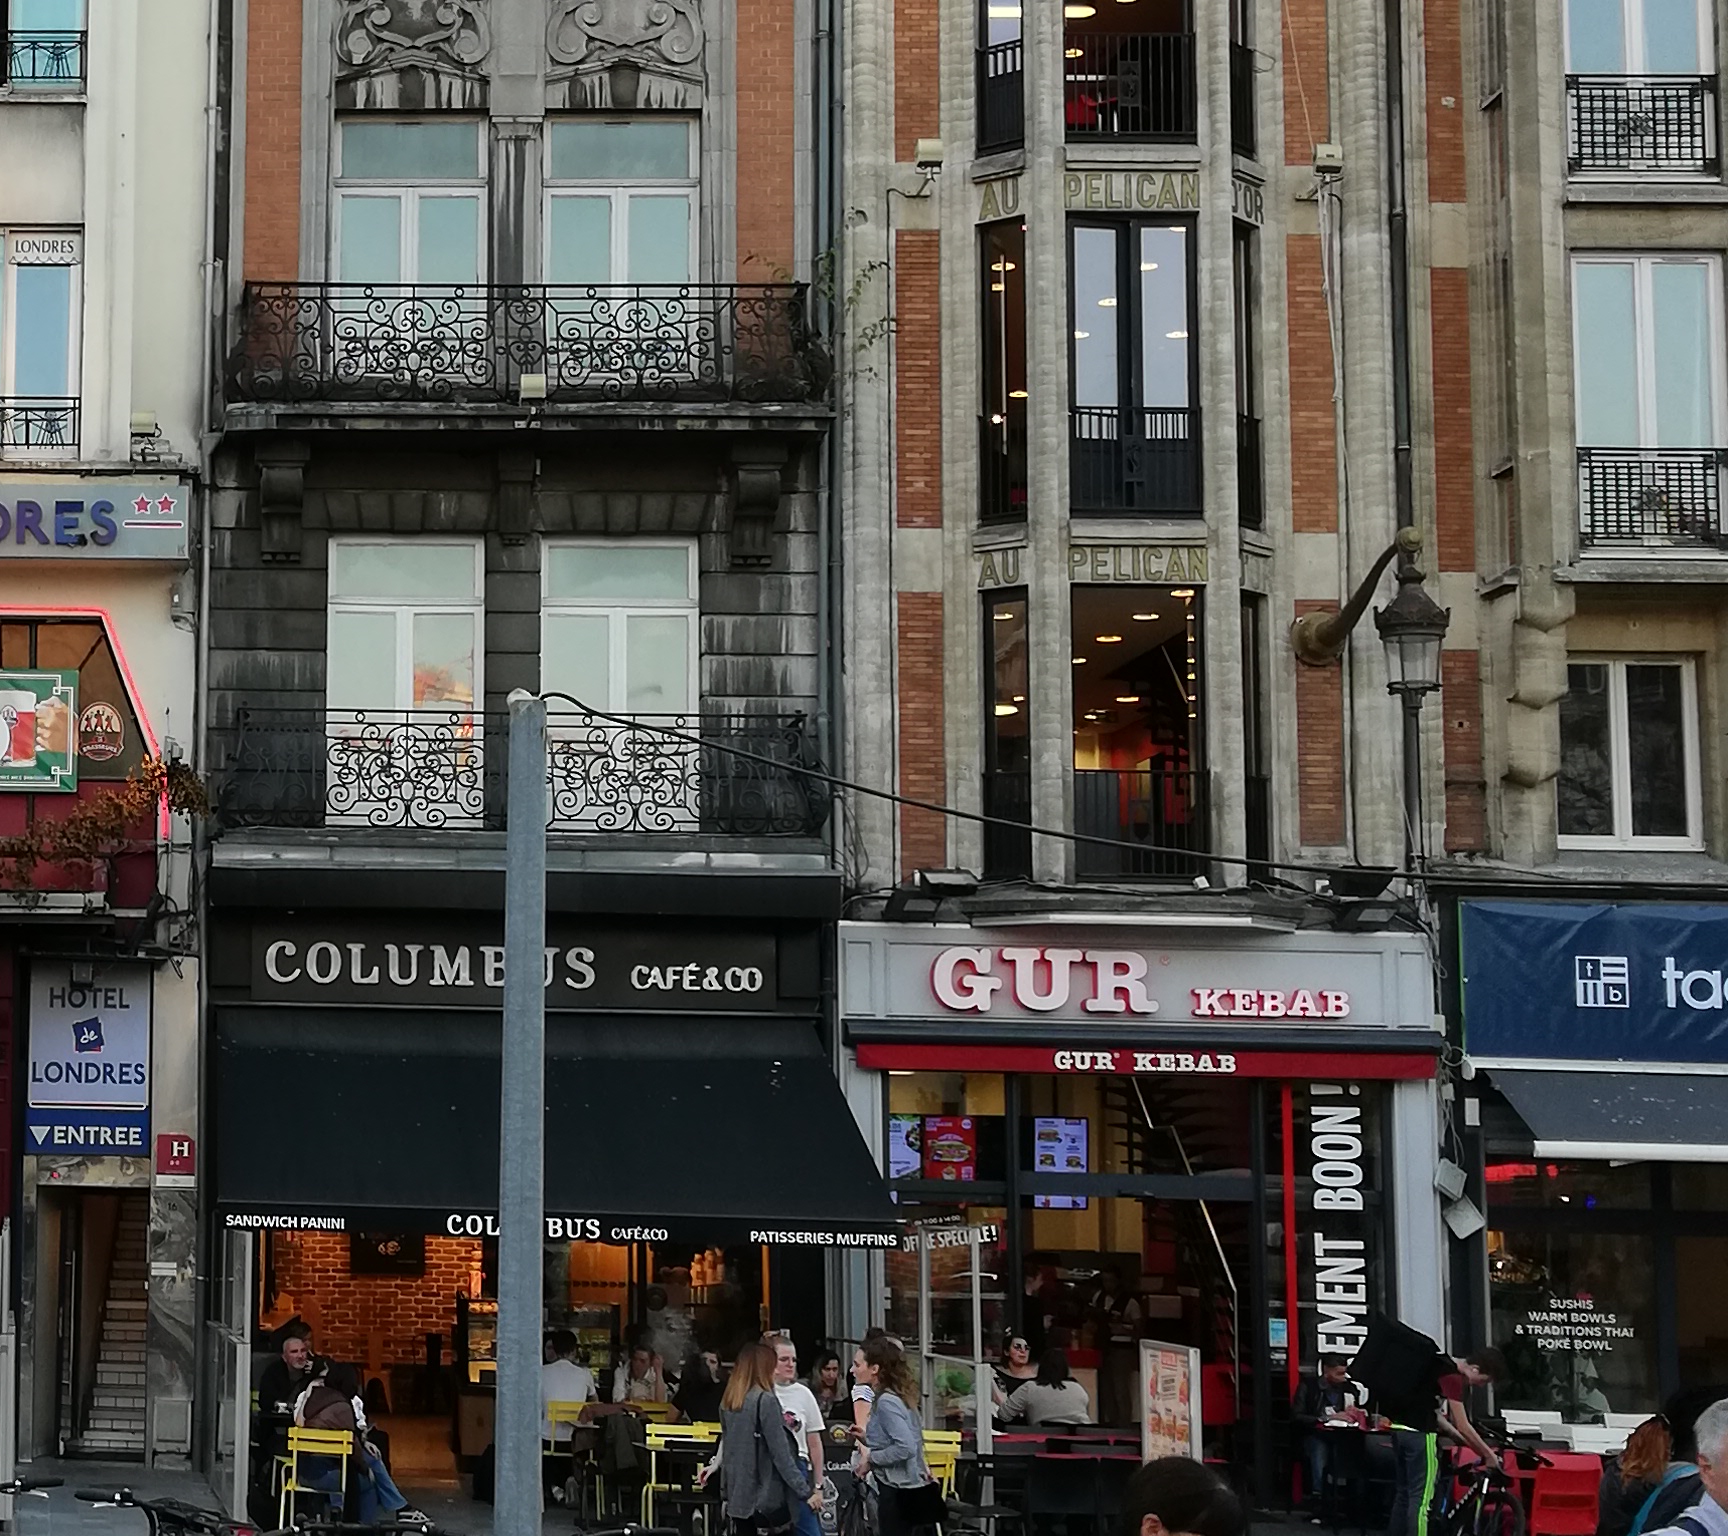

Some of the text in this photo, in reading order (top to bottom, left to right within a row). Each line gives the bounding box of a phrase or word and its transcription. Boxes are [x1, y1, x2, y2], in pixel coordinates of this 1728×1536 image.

[978, 175, 1019, 221] AU
[1064, 173, 1200, 209] PELICAN
[15, 239, 74, 254] LONDRES
[978, 548, 1019, 587] AU
[1068, 547, 1209, 582] PELICAN
[630, 962, 764, 993] CAFÉ&CO
[930, 947, 1351, 1019] GUR KEBAB
[1662, 957, 1728, 1009] ta
[49, 987, 130, 1009] HOTEL
[80, 1027, 98, 1043] de
[1053, 1050, 1237, 1073] GUR KEBAB
[32, 1061, 146, 1085] LONDRES
[54, 1125, 143, 1146] ENTREE
[172, 1141, 190, 1157] H
[1310, 1106, 1364, 1211] BOON
[225, 1214, 347, 1230] SANDWICH PANINI
[446, 1214, 668, 1241] COLBUS CAFÉ&CO
[749, 1230, 897, 1248] PATISSERIES MUFFINS
[1550, 1299, 1593, 1310] SUSHIS
[1528, 1311, 1616, 1324] WARM BOWLS
[1515, 1325, 1523, 1334] &
[1526, 1325, 1601, 1337] TRADITIONS
[1574, 1340, 1613, 1351] BOWL
